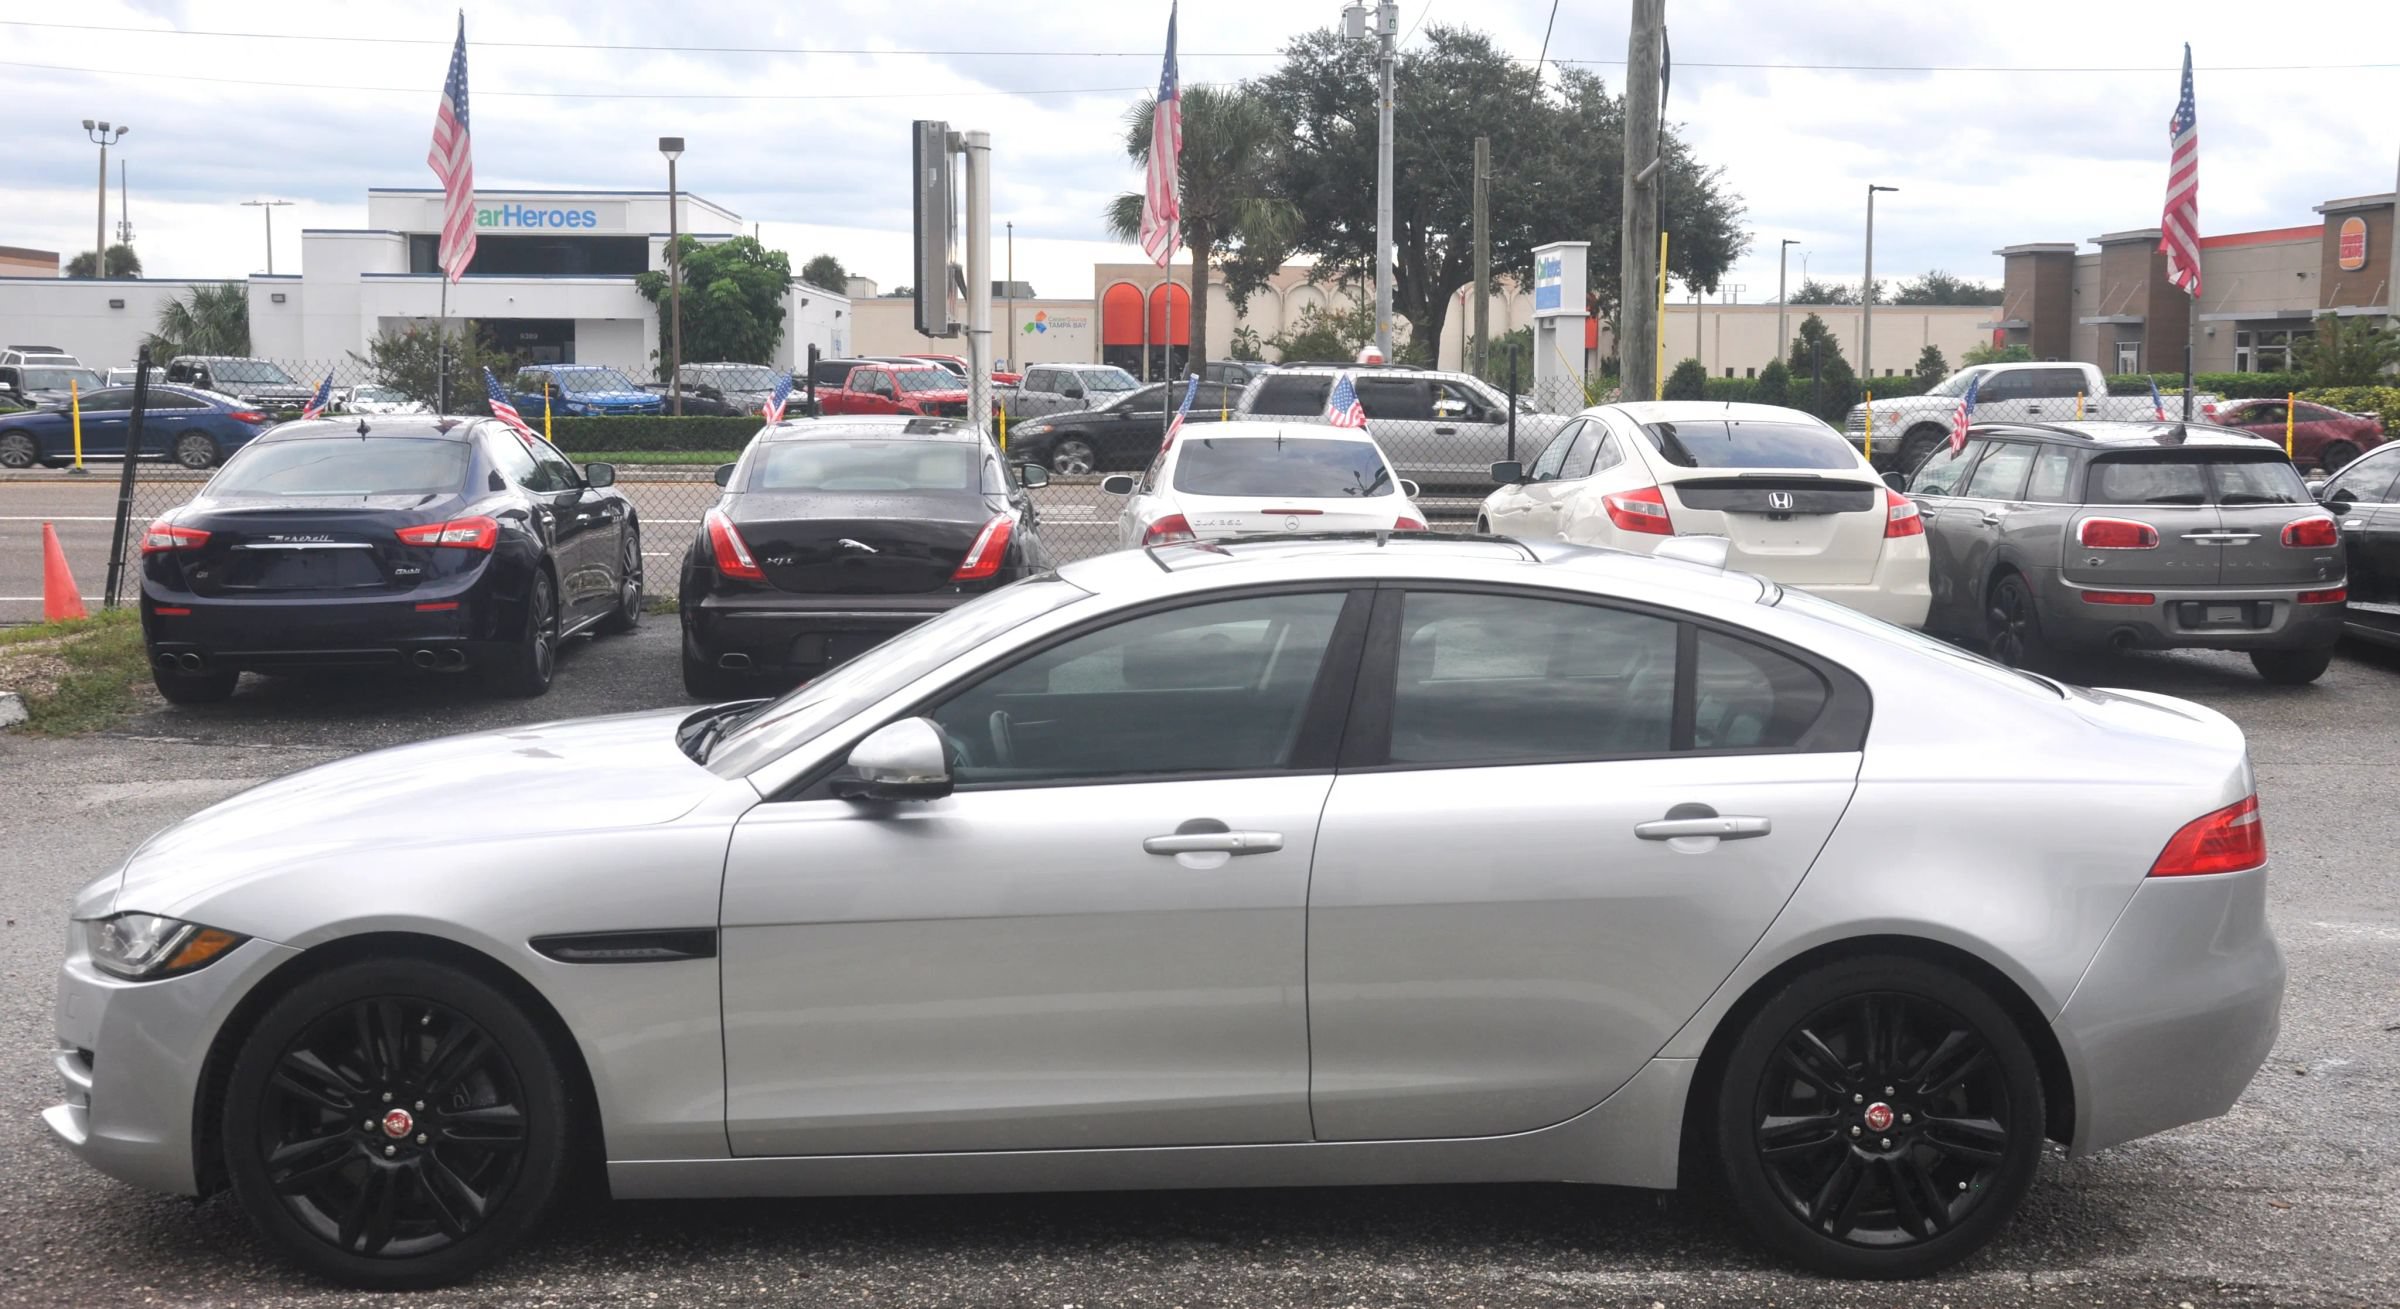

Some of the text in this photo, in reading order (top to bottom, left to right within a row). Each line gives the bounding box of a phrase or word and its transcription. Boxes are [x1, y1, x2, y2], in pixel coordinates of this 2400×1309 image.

[474, 204, 597, 228] arHeroes
[1048, 321, 1087, 329] TAMPA BAY
